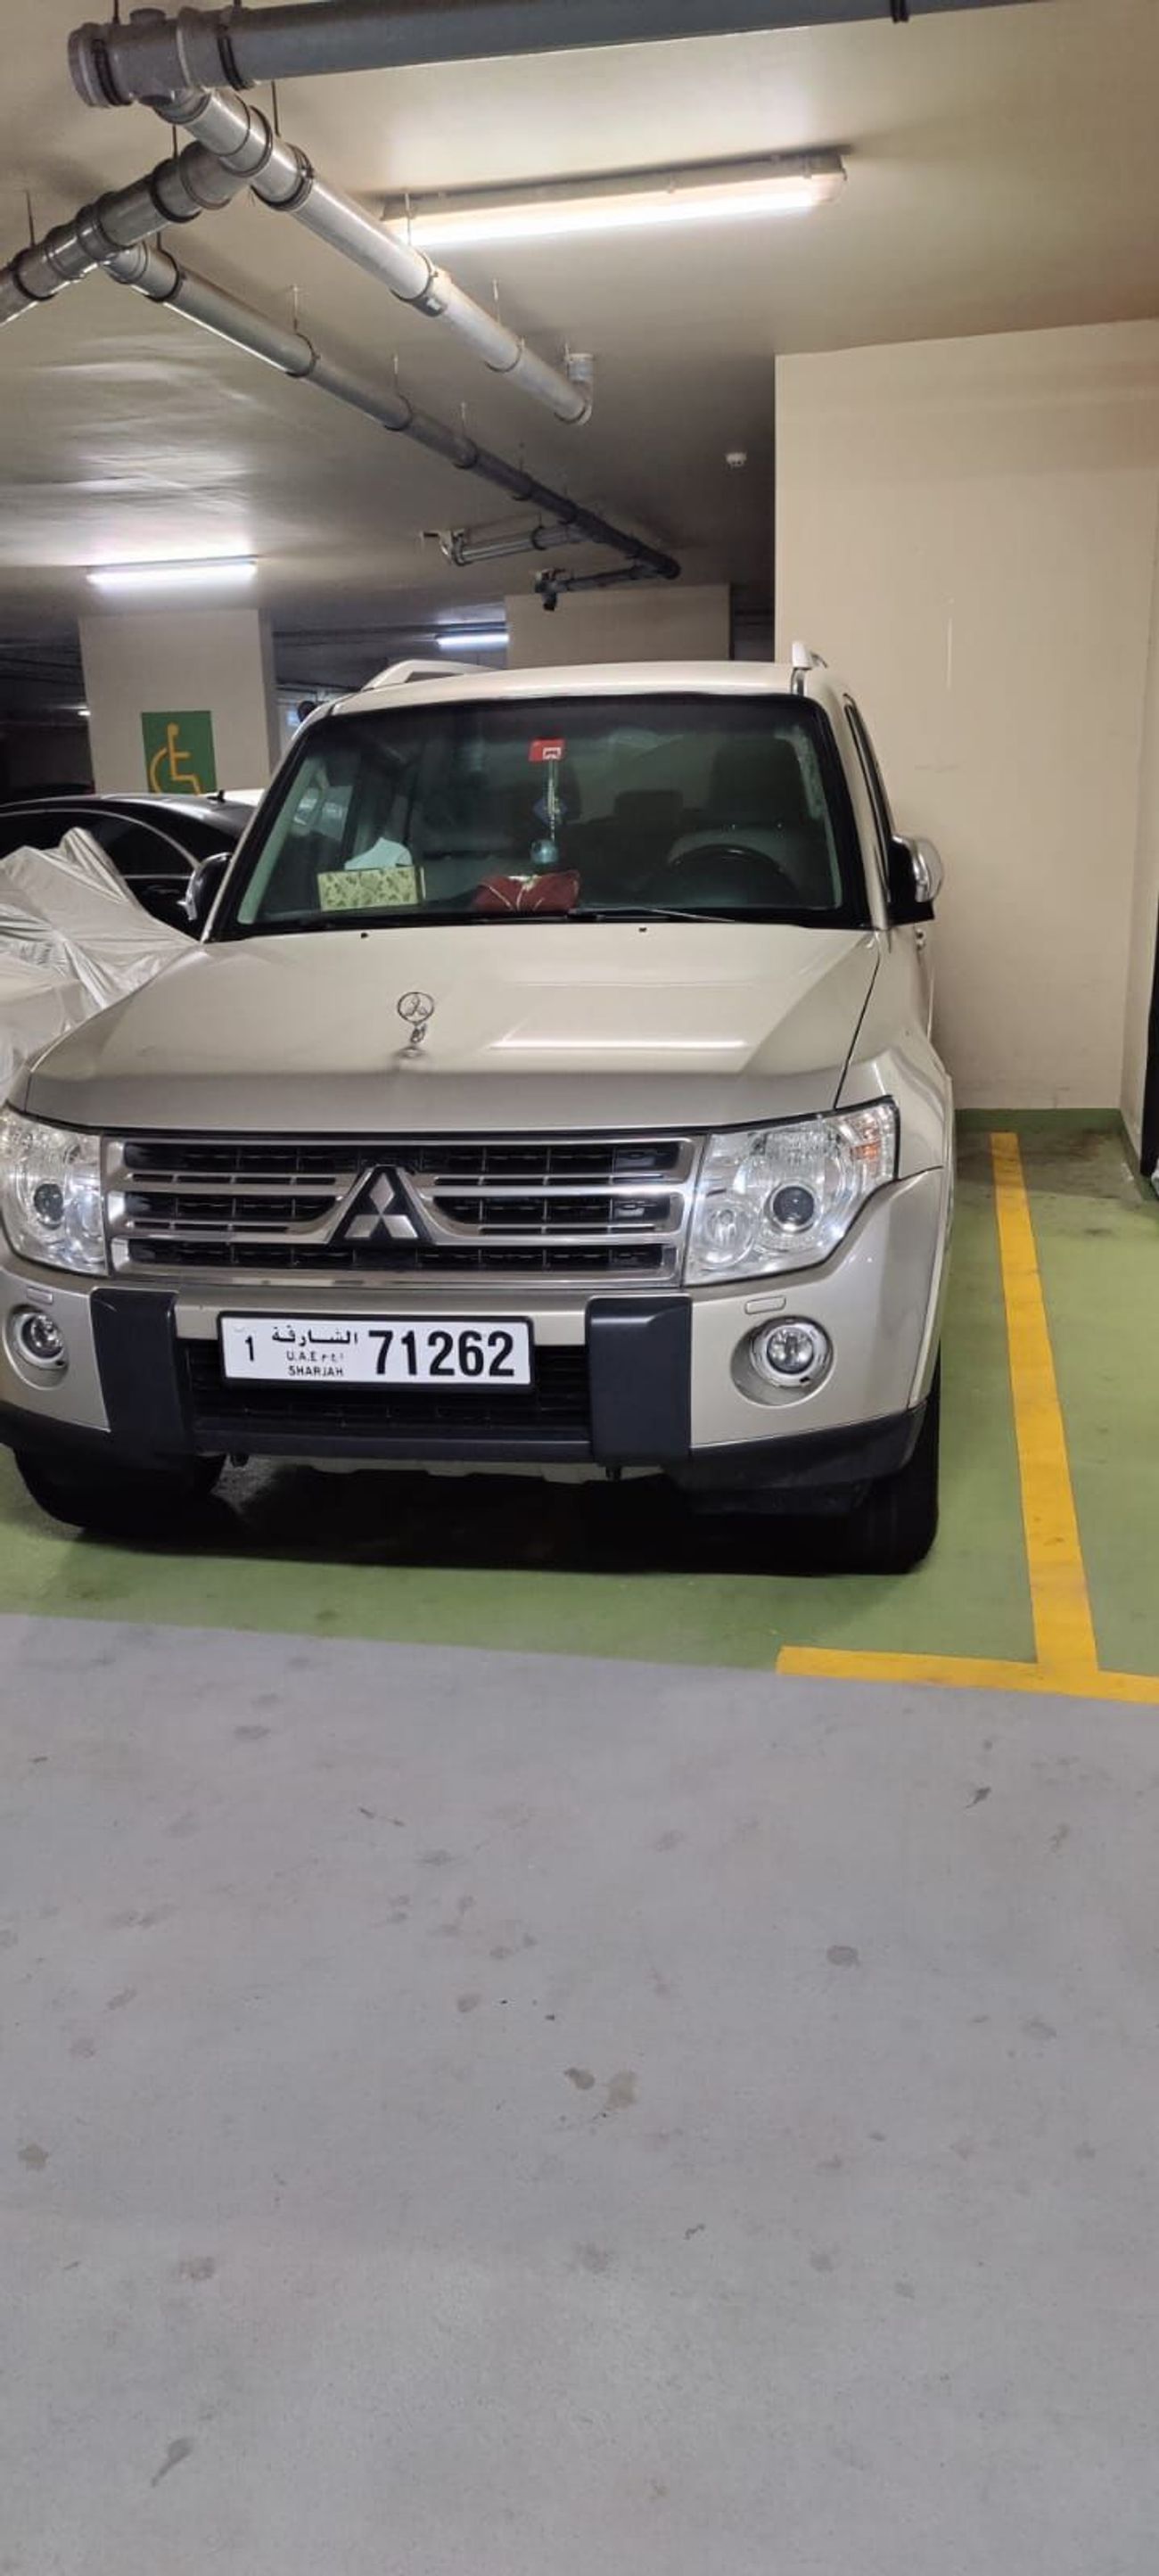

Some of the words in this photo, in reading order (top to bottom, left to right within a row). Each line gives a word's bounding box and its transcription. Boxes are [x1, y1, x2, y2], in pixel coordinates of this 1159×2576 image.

[272, 1324, 358, 1346] الشارقة
[245, 1335, 254, 1362] 1
[368, 1329, 514, 1377] 71262
[288, 1365, 344, 1377] SHARJAH
